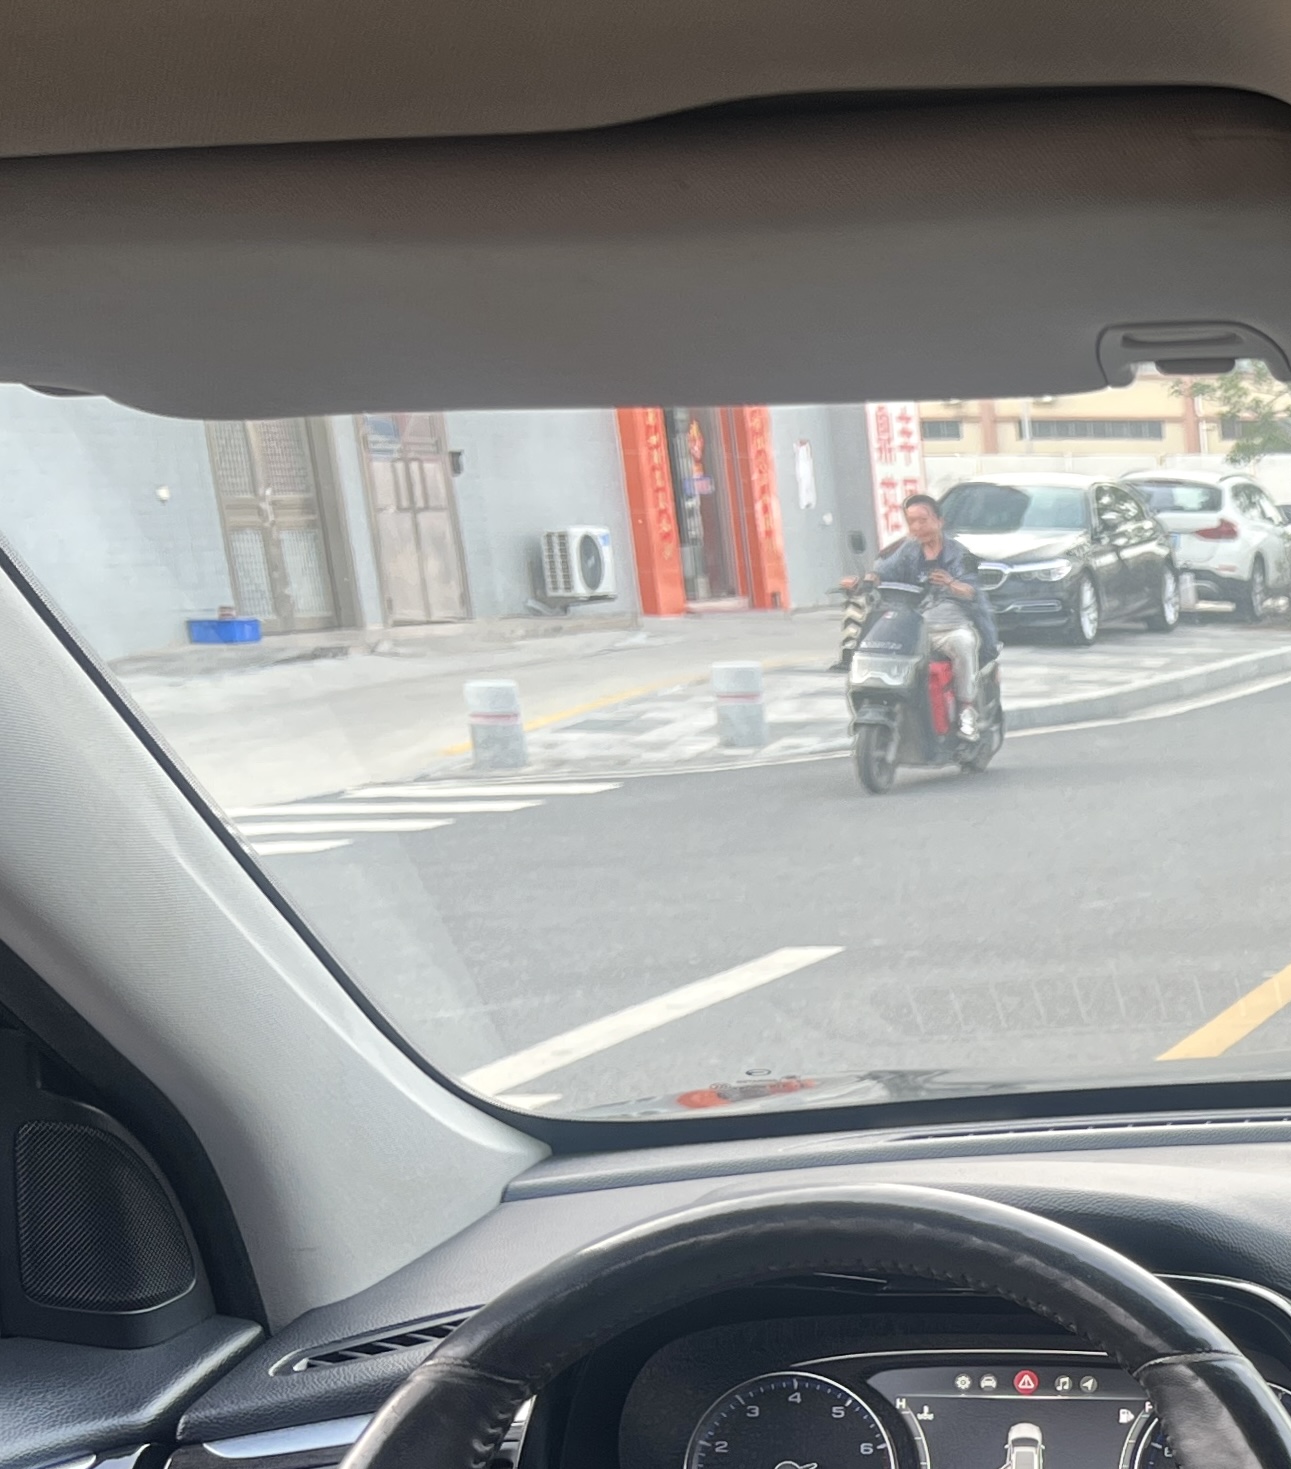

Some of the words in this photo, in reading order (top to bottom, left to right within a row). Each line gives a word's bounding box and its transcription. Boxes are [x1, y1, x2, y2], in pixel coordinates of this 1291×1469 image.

[788, 1392, 802, 1403] 4
[896, 1398, 907, 1409] H
[747, 1405, 760, 1417] 3
[831, 1406, 845, 1418] 5
[715, 1441, 728, 1452] 2
[860, 1443, 874, 1454] 6
